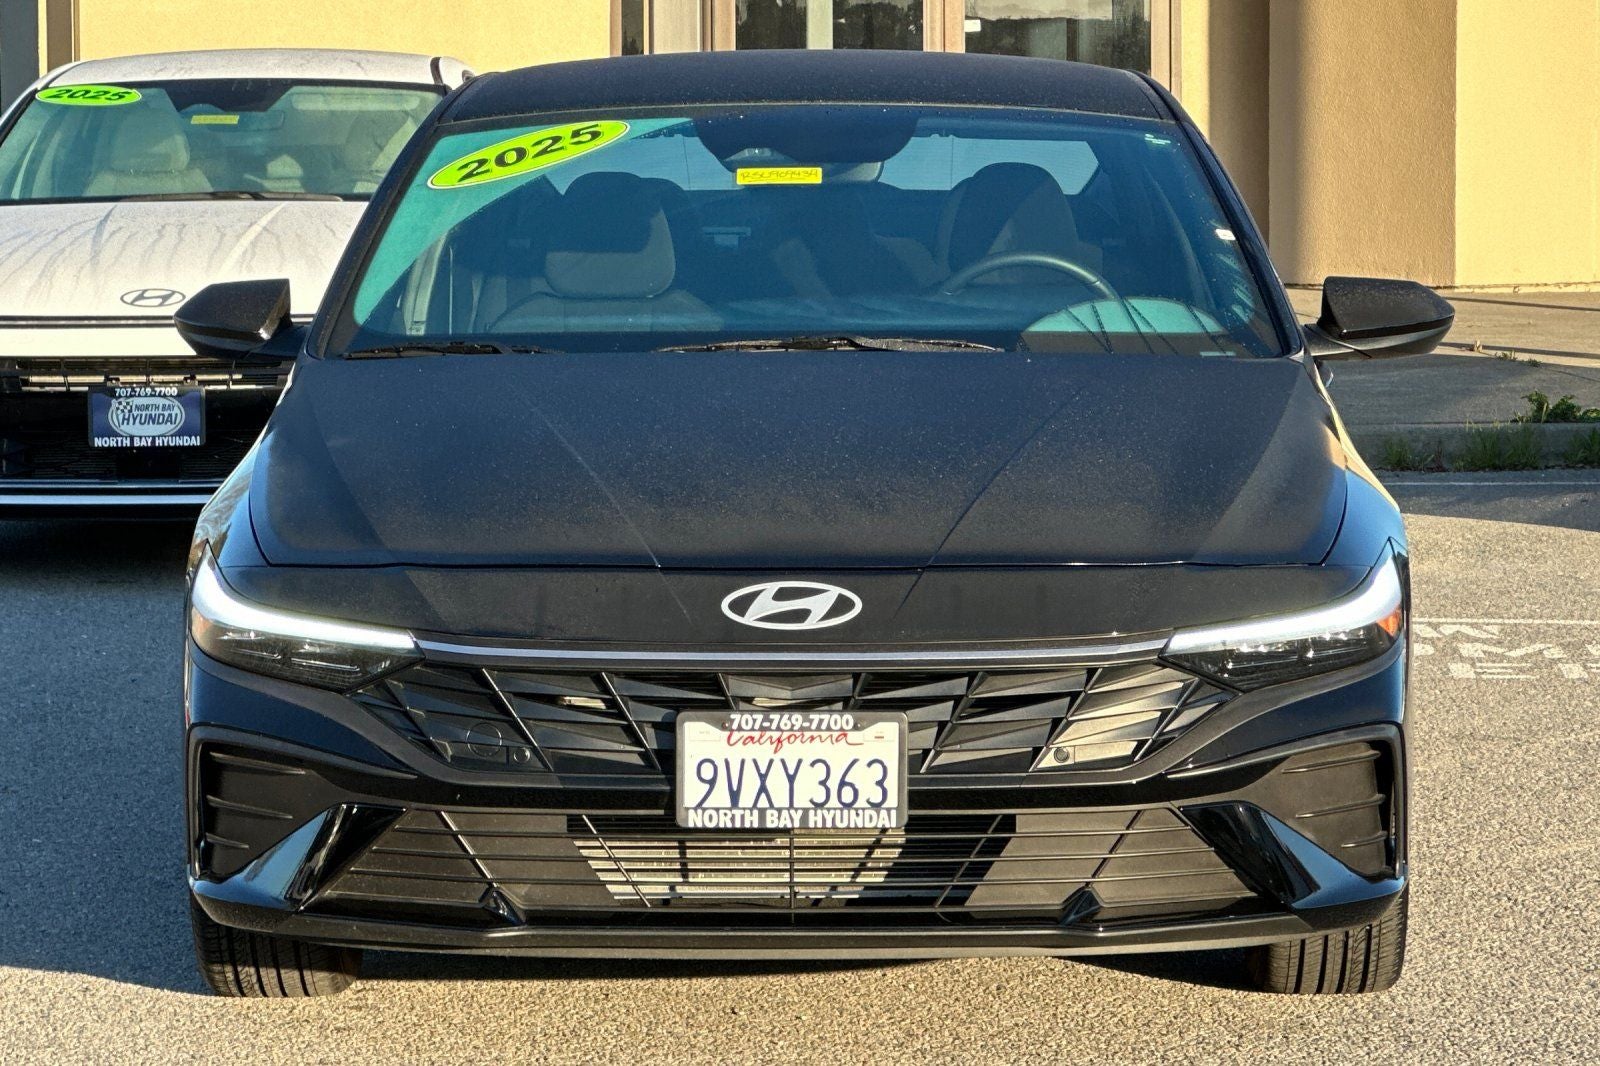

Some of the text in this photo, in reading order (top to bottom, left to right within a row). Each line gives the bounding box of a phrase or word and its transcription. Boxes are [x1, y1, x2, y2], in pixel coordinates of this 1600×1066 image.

[47, 89, 133, 101] 2025
[457, 124, 603, 183] 2025
[115, 387, 178, 397] 707-769-7700
[134, 403, 176, 412] NORTH BAY
[121, 413, 178, 426] HYUNDAI
[94, 436, 201, 447] NORTH BAY HYUNDAI
[730, 714, 854, 731] 707-769-7700
[726, 730, 864, 754] California
[696, 758, 889, 808] 9VXY363
[688, 809, 897, 828] NORTH BAY HYUNDAI
